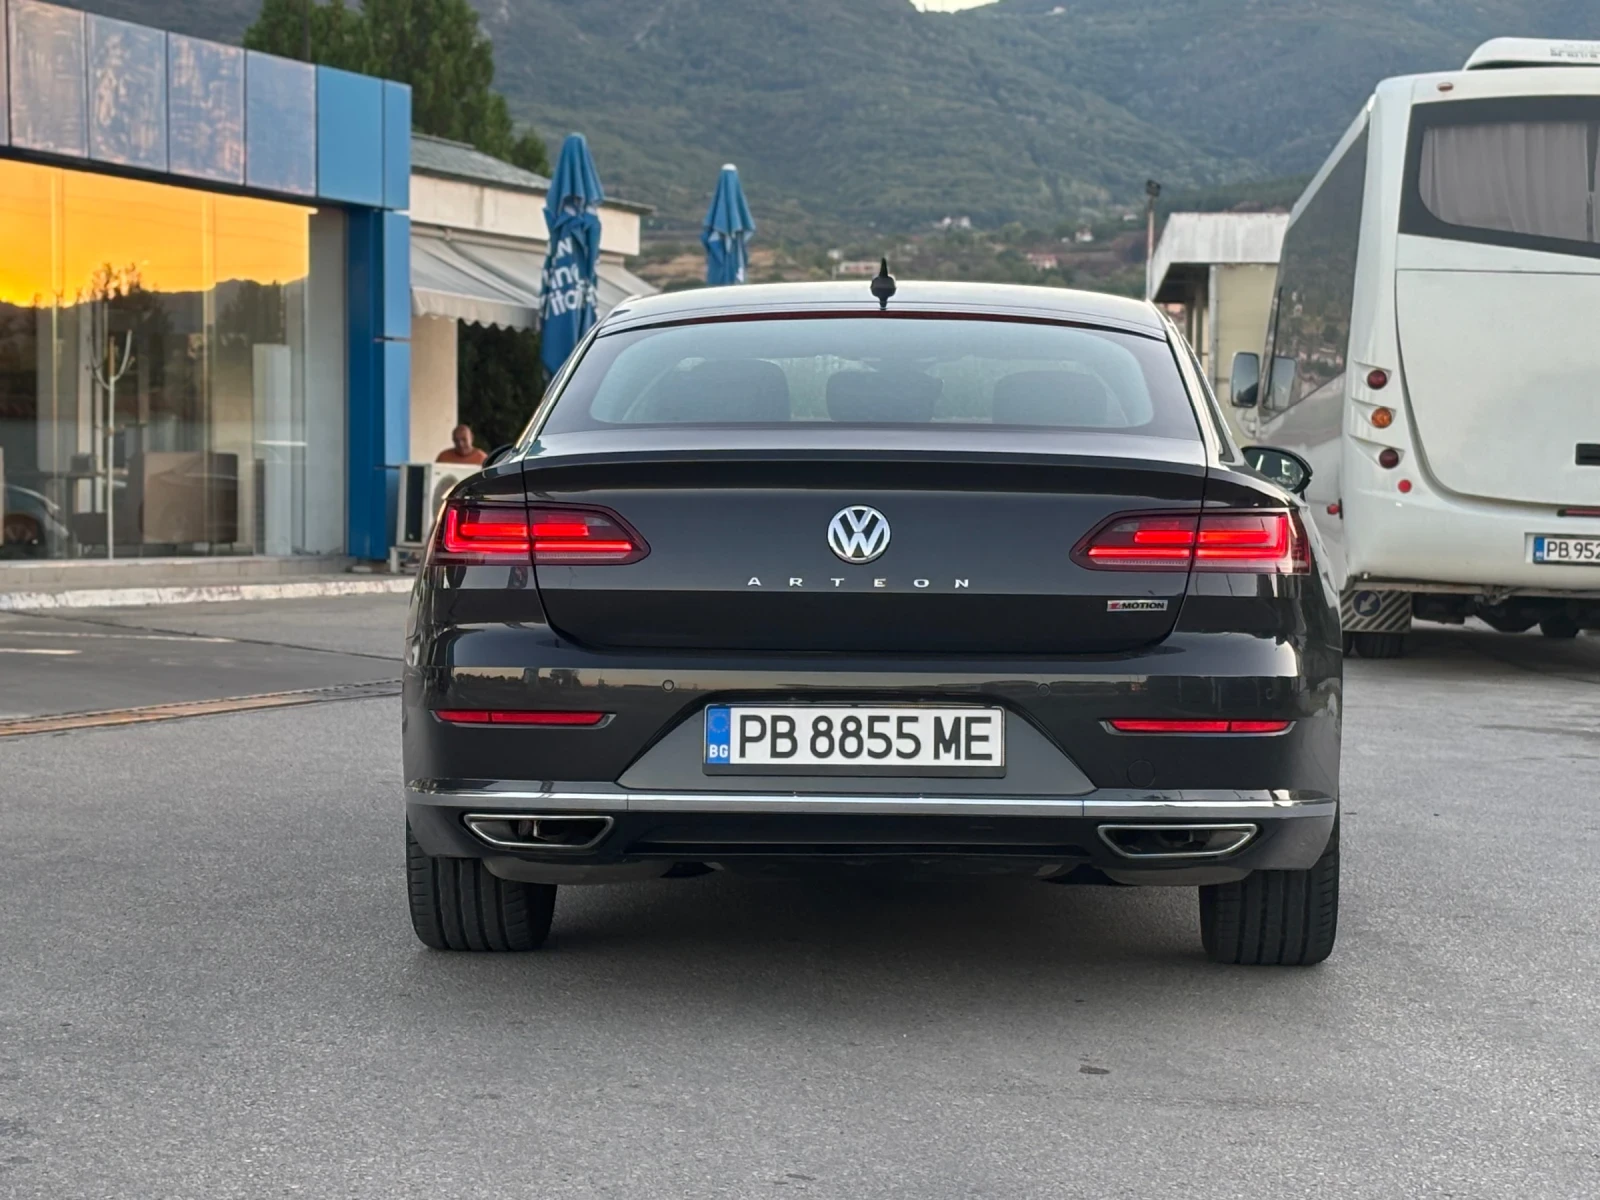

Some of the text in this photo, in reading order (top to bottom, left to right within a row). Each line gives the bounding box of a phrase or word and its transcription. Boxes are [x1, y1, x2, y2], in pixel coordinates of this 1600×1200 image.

[1546, 541, 1569, 558] PB
[747, 577, 969, 588] ARTEON
[739, 714, 993, 760] PB 8855 ME
[709, 745, 728, 758] BG
